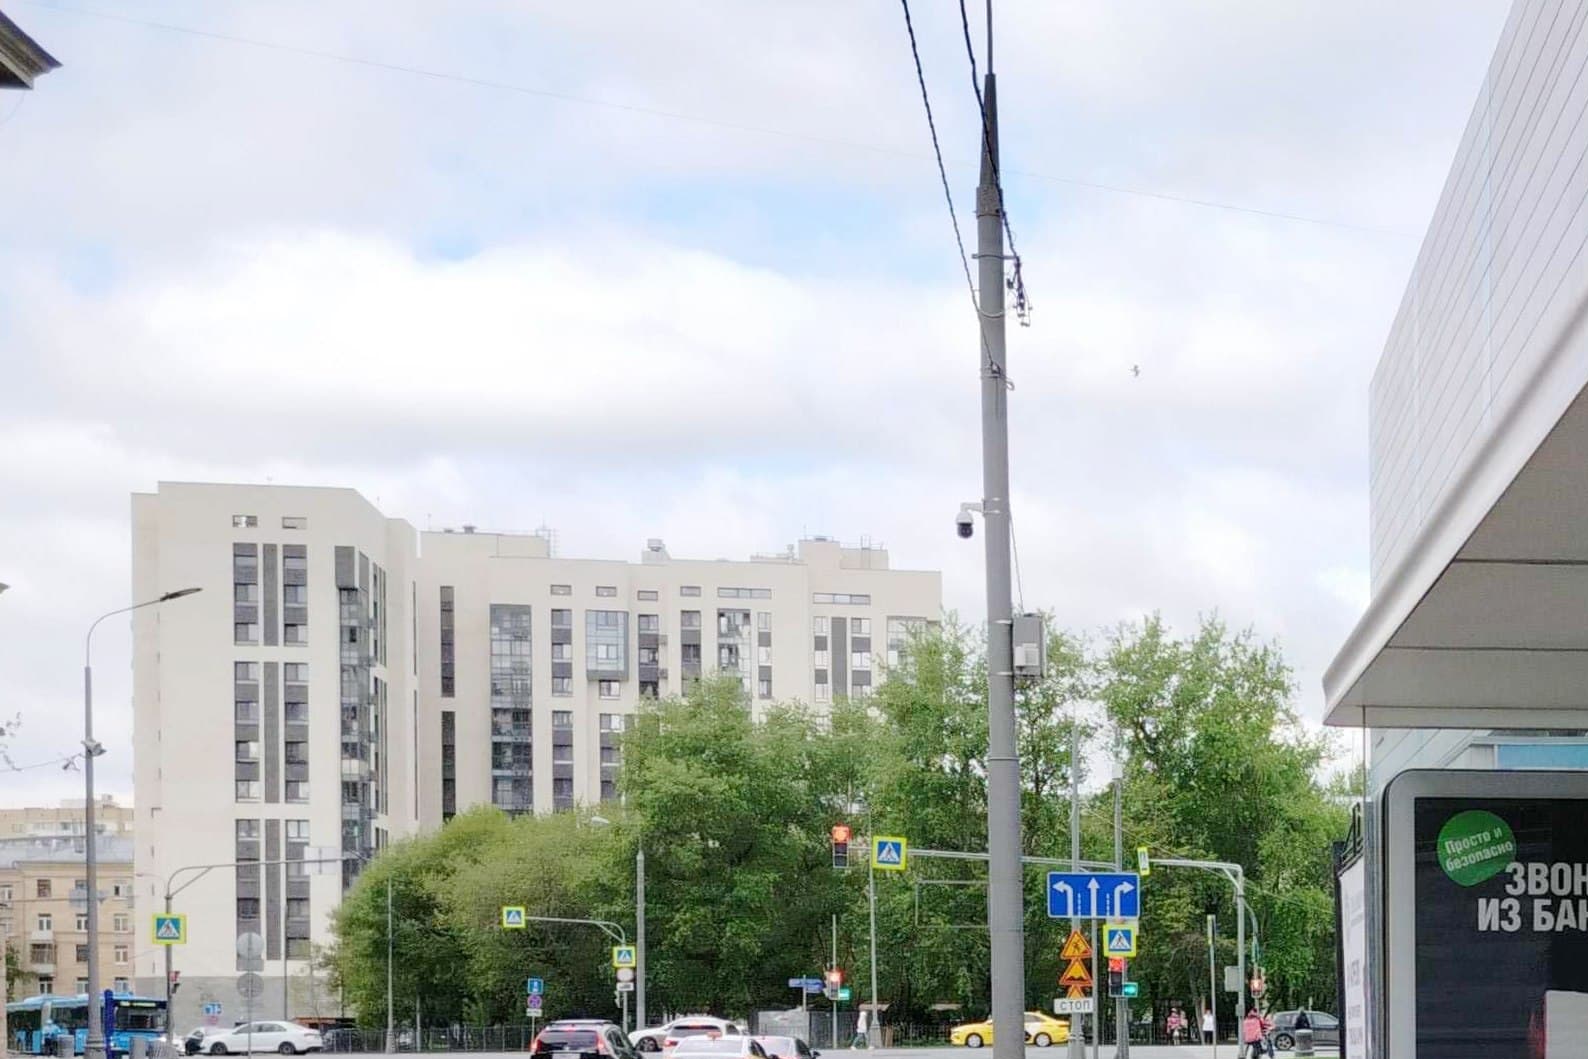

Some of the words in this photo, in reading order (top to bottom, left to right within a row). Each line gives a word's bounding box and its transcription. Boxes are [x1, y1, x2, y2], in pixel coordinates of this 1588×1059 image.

[1445, 831, 1491, 854] Просто
[1493, 827, 1503, 839] и
[1446, 841, 1513, 871] безопасно
[1477, 897, 1521, 932] ИЗ
[1060, 1000, 1091, 1011] СТОП
